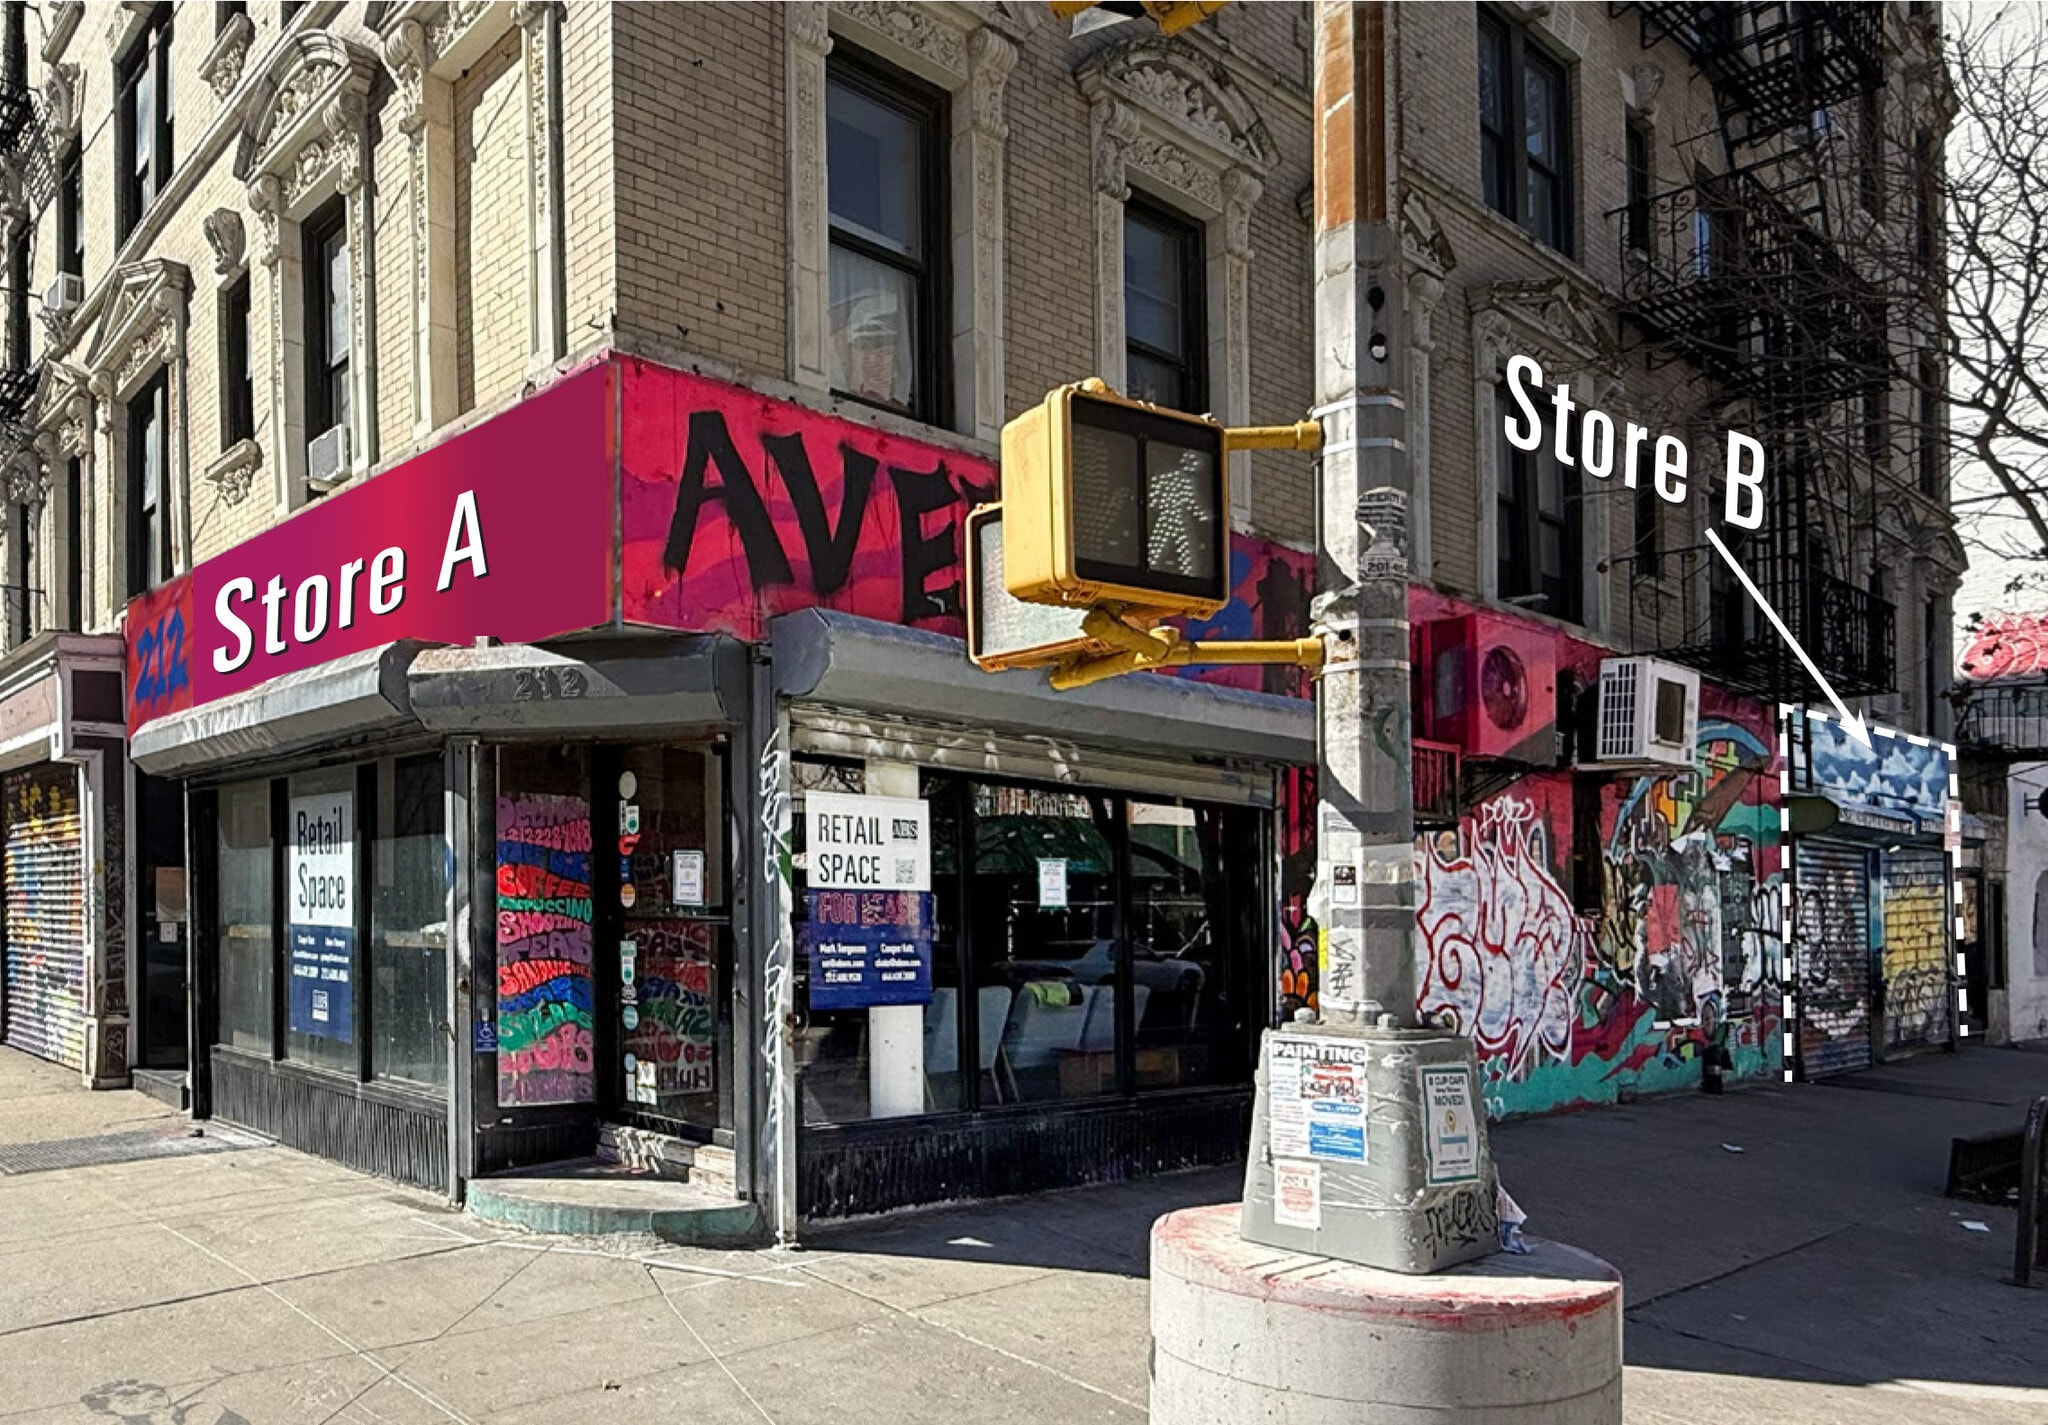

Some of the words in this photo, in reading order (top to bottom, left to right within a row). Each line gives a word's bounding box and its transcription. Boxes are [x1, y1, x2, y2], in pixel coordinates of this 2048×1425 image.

[661, 409, 963, 627] AVE
[134, 606, 189, 708] 212
[514, 665, 583, 700] 212
[297, 806, 343, 855] Retail
[818, 812, 885, 846] RETAIL
[497, 863, 591, 899] COFFEE
[818, 853, 881, 885] SPACE
[297, 862, 347, 919] Space
[818, 892, 858, 924] FOR
[860, 893, 920, 927] LEASE
[1272, 1040, 1365, 1066] PAINTING
